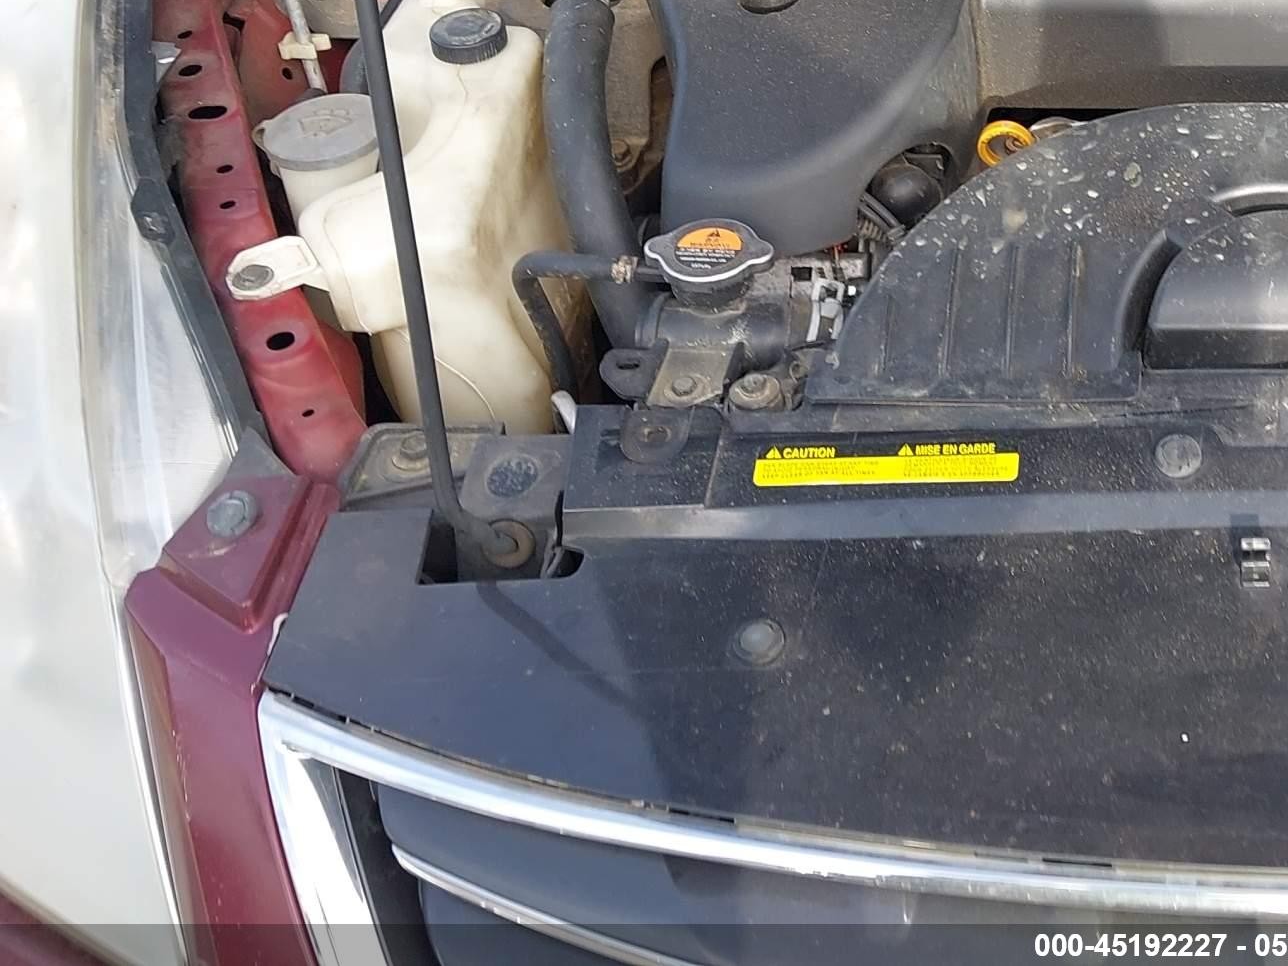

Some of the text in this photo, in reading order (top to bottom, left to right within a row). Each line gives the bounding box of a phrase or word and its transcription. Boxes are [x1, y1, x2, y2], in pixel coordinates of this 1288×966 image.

[782, 446, 836, 459] CAUTION
[915, 442, 996, 455] MISE EN GARDE
